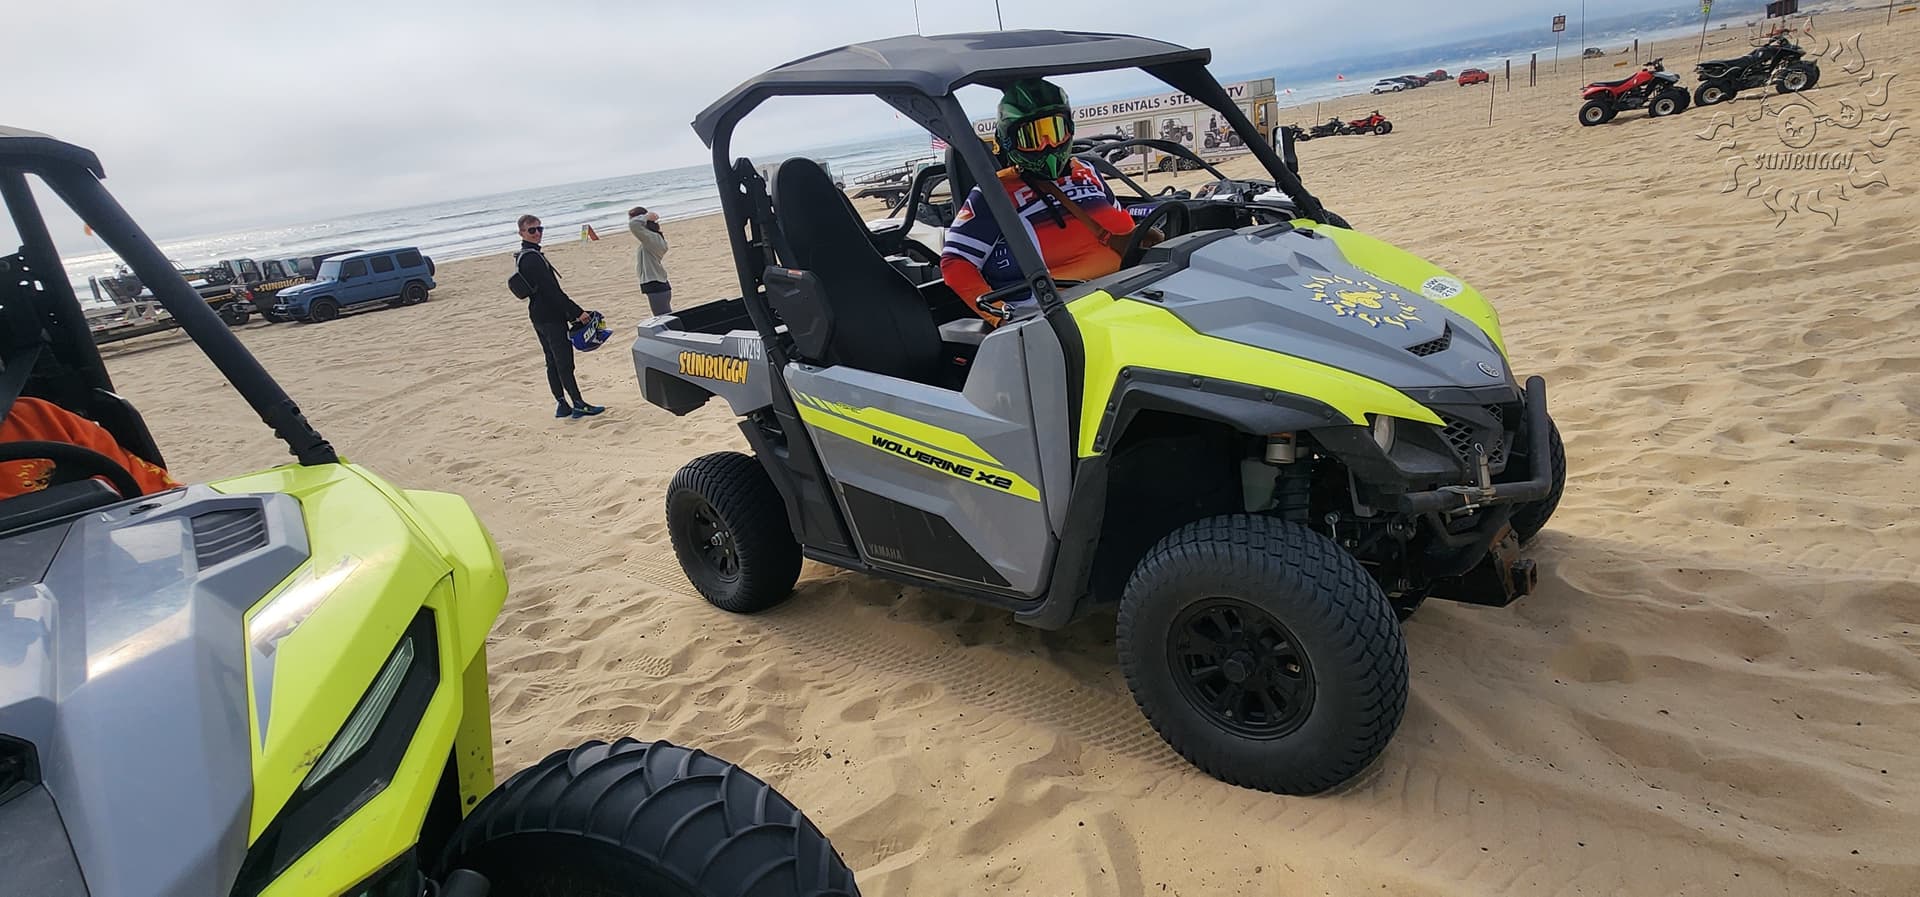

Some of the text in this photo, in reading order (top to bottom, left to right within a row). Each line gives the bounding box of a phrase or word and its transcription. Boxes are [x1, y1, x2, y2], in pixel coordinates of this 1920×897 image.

[1079, 105, 1109, 119] SIDES
[1112, 98, 1161, 115] RENTALS
[1223, 86, 1244, 98] TV
[1129, 207, 1148, 216] RENT
[737, 338, 761, 360] UW219
[678, 350, 749, 385] SUNBUGGY
[871, 434, 1013, 490] WOLVERINE X2
[868, 543, 904, 561] YAMAHA
